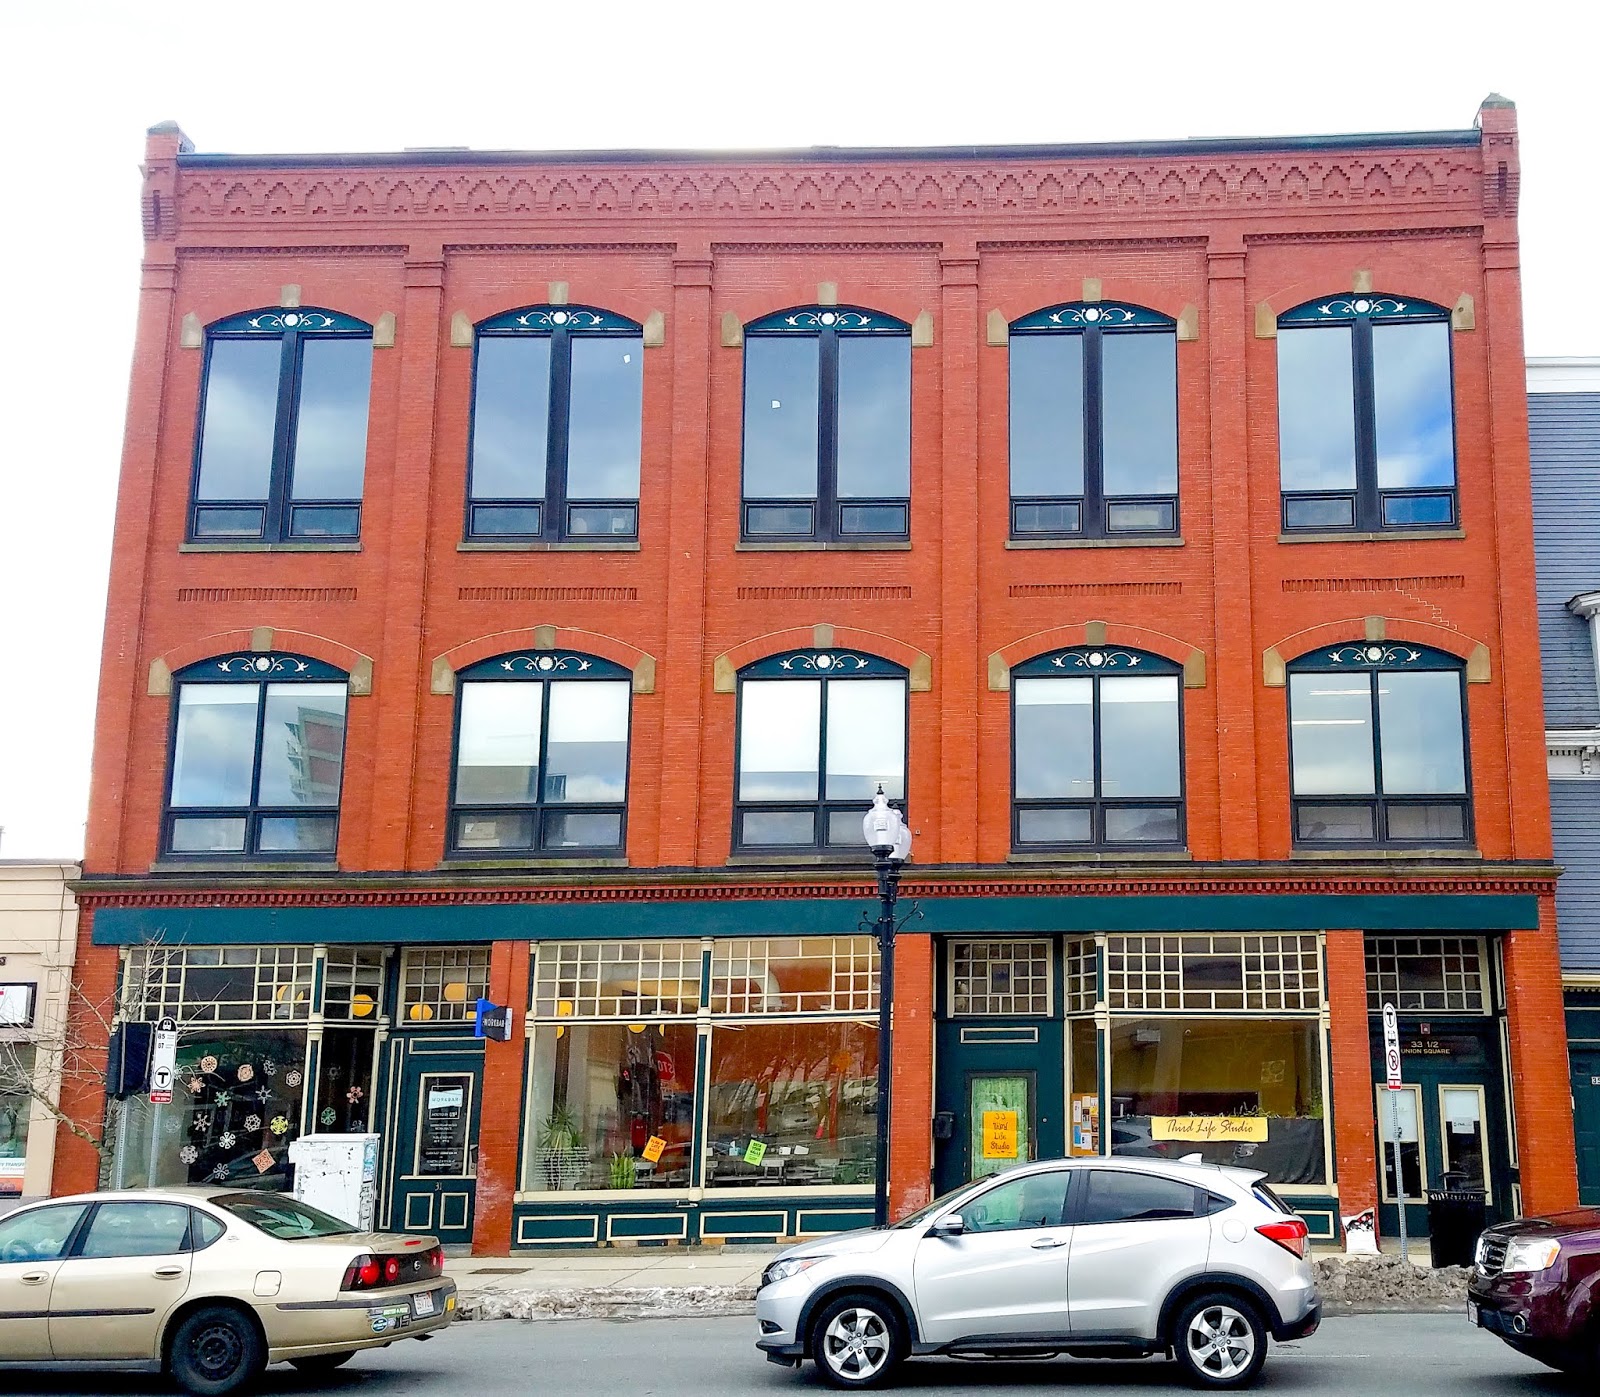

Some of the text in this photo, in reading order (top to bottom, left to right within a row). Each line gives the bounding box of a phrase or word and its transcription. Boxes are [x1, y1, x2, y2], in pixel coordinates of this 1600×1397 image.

[157, 1071, 169, 1084] T
[1167, 1119, 1253, 1139] Third Life Studio
